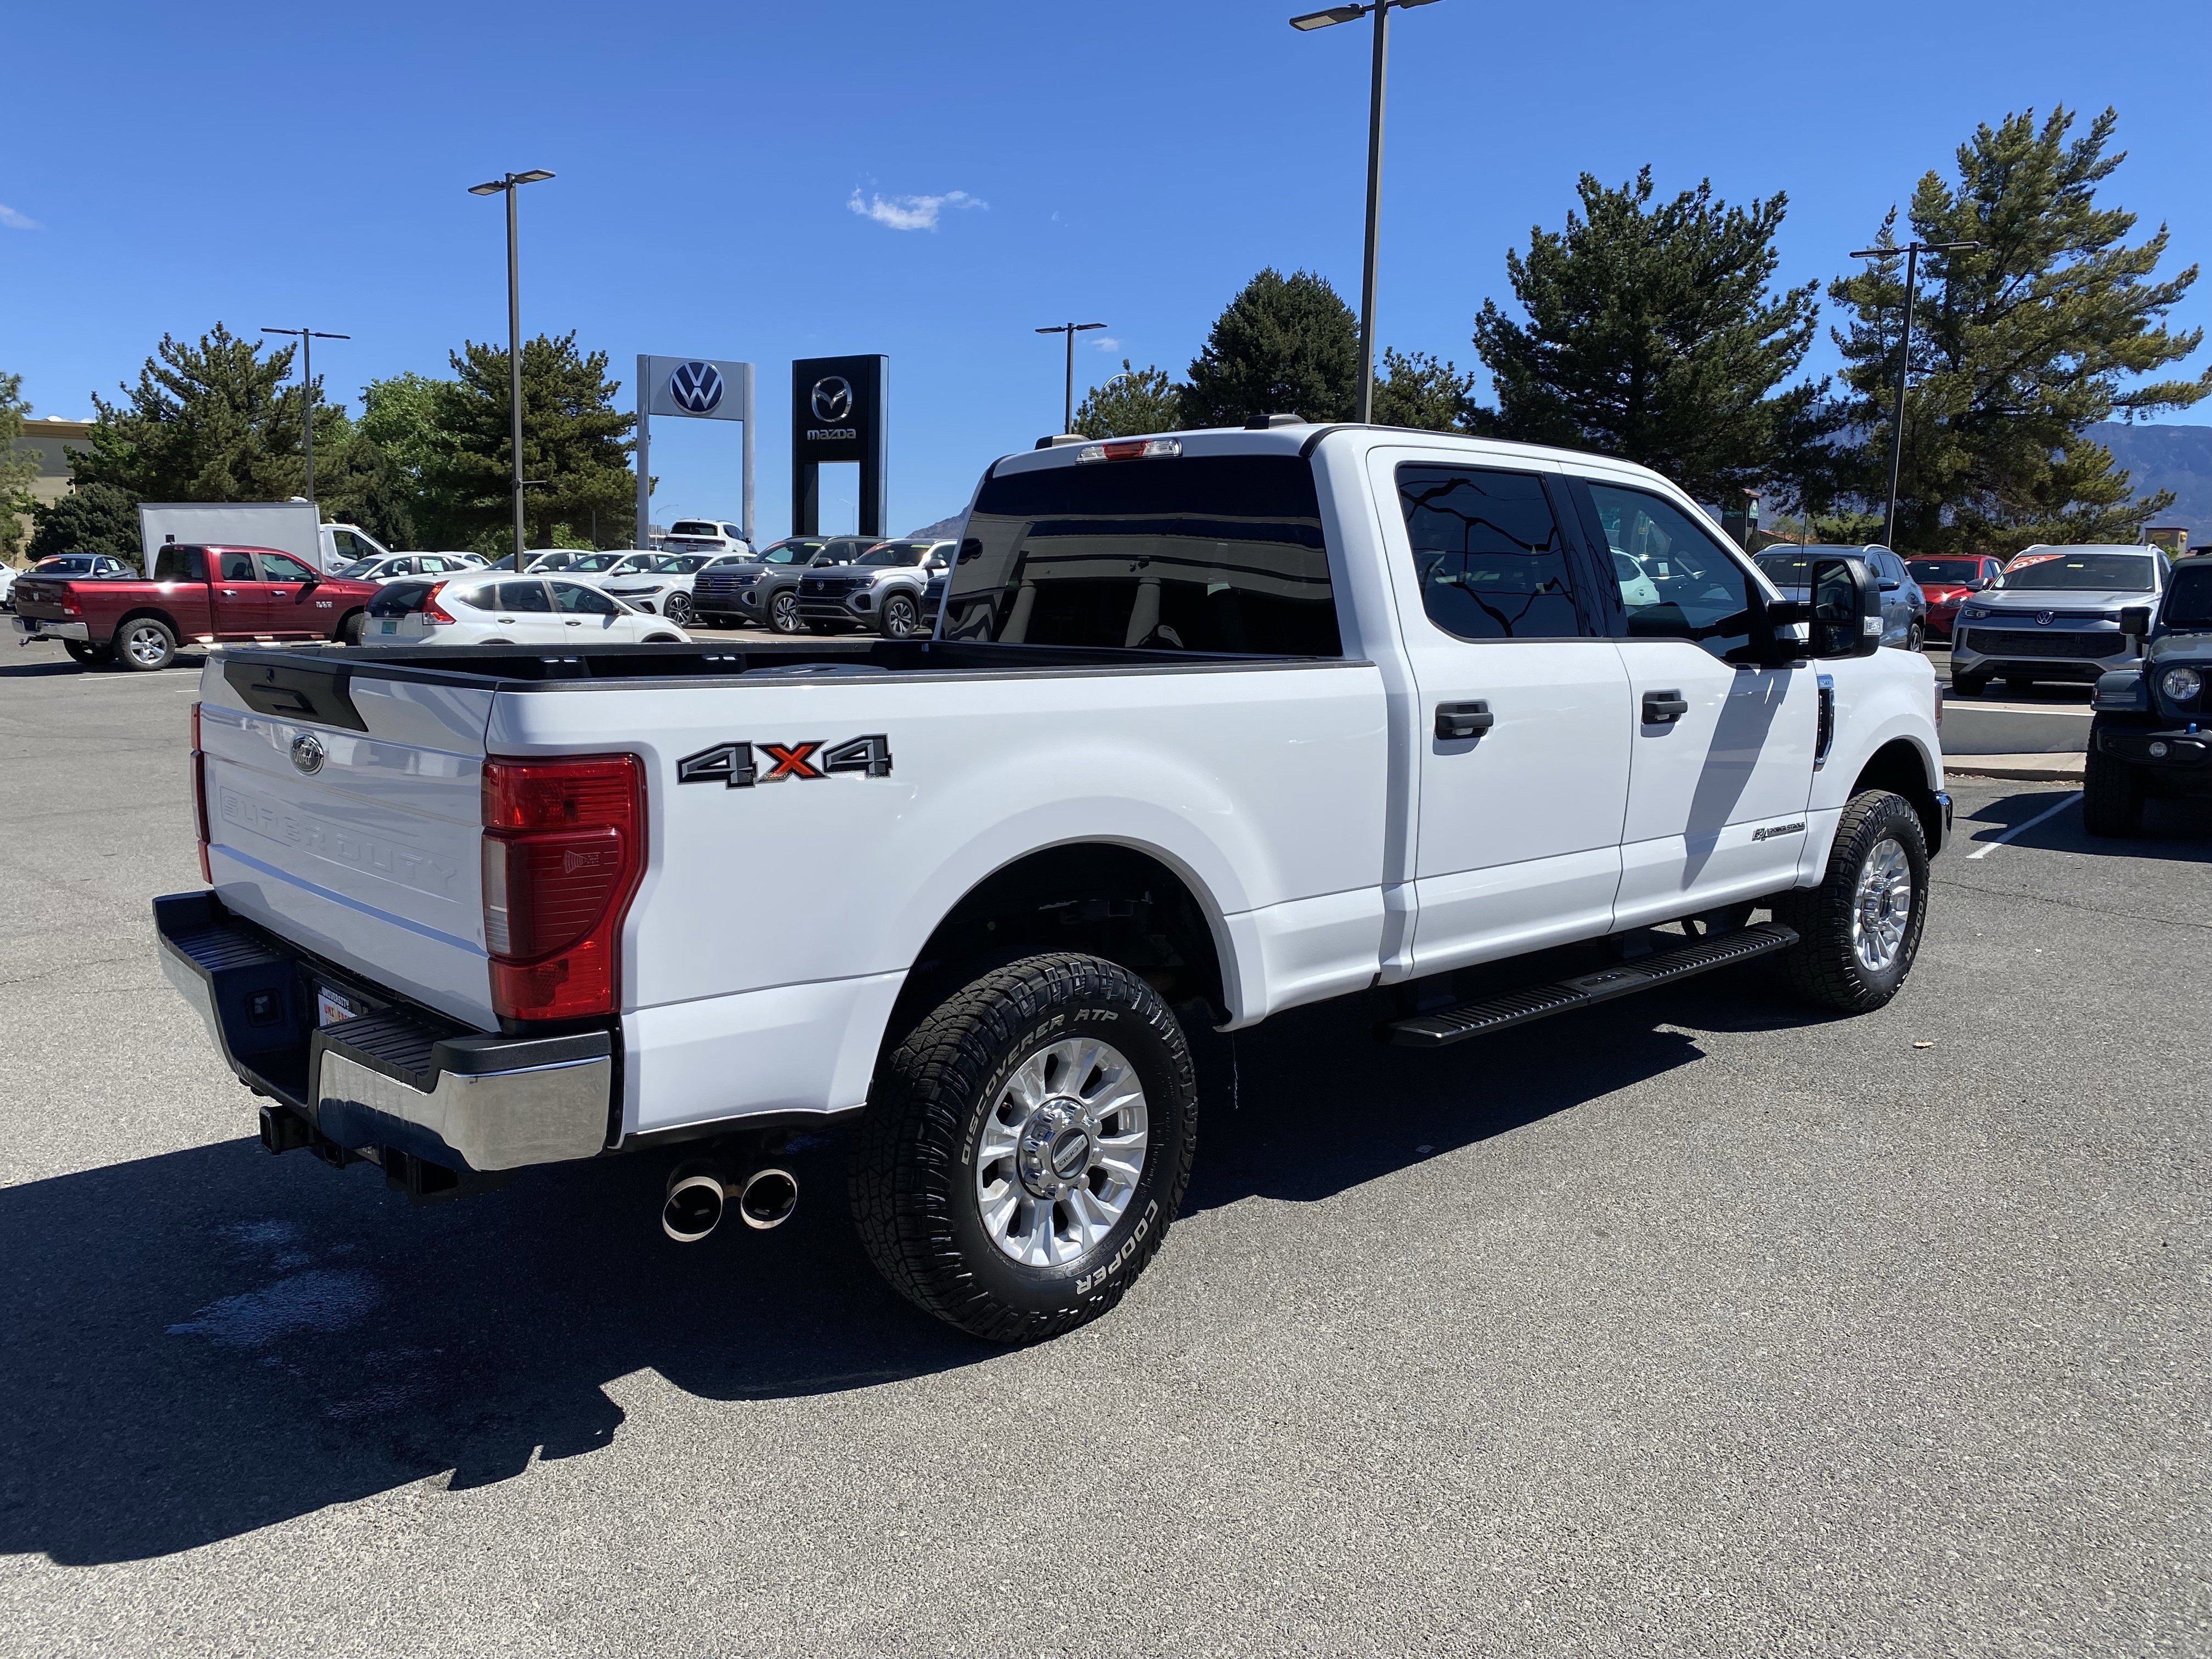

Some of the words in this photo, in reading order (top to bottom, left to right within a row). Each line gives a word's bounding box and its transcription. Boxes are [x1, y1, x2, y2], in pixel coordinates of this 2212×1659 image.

[223, 794, 326, 851] SUPER
[336, 832, 458, 890] DUTY
[961, 1013, 1065, 1165] DISCOVERER
[1074, 1008, 1119, 1022] ATP
[1058, 1139, 1085, 1166] FORD
[1075, 1199, 1159, 1295] COOPER
